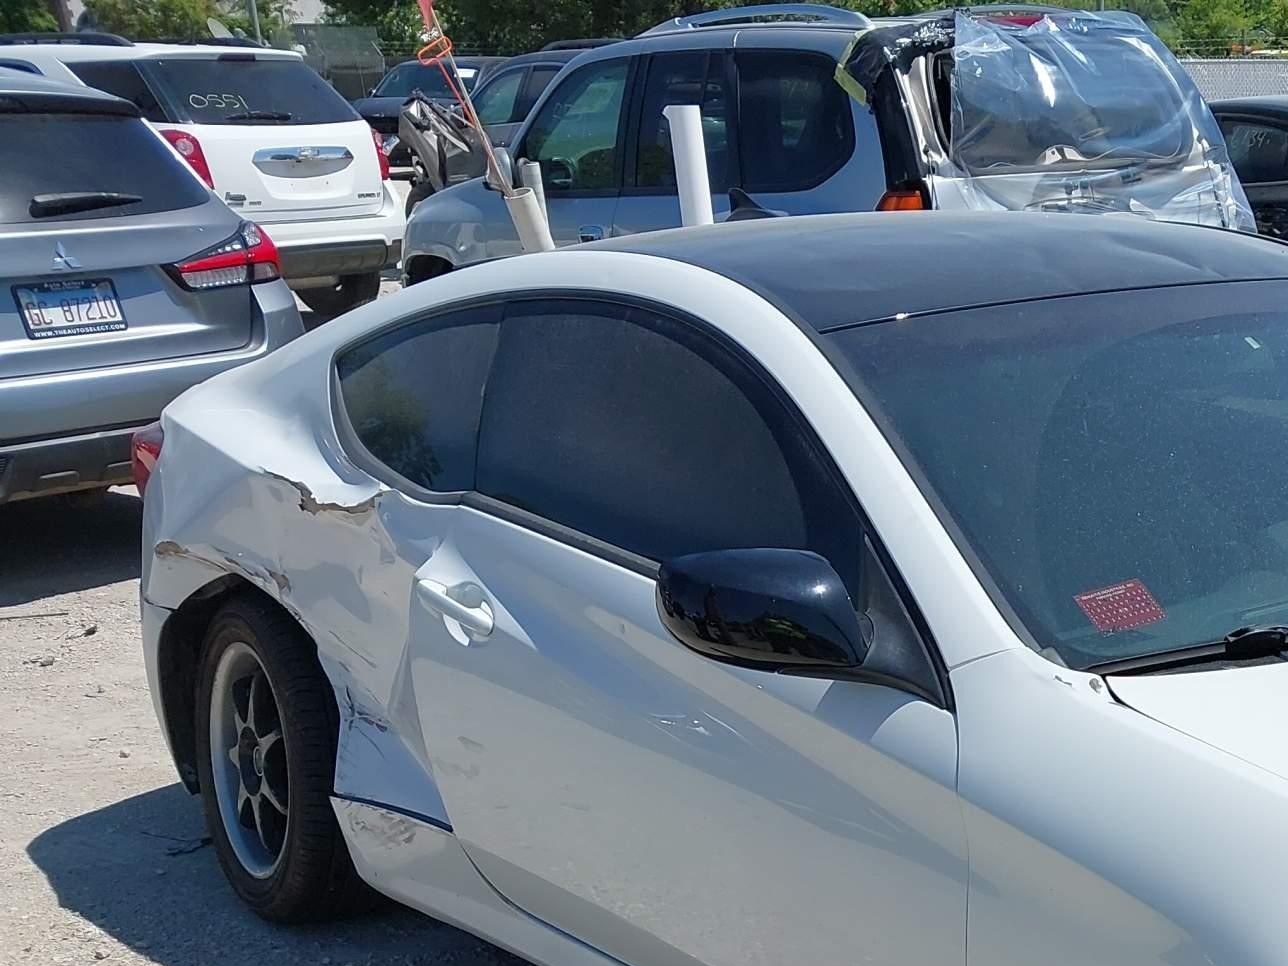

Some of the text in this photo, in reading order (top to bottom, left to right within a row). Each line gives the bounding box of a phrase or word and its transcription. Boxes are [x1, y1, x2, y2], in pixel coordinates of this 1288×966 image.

[189, 93, 248, 109] 0551
[25, 295, 118, 326] GC 87210
[34, 323, 126, 338] WWW.THEAUTOSELECT.COM
